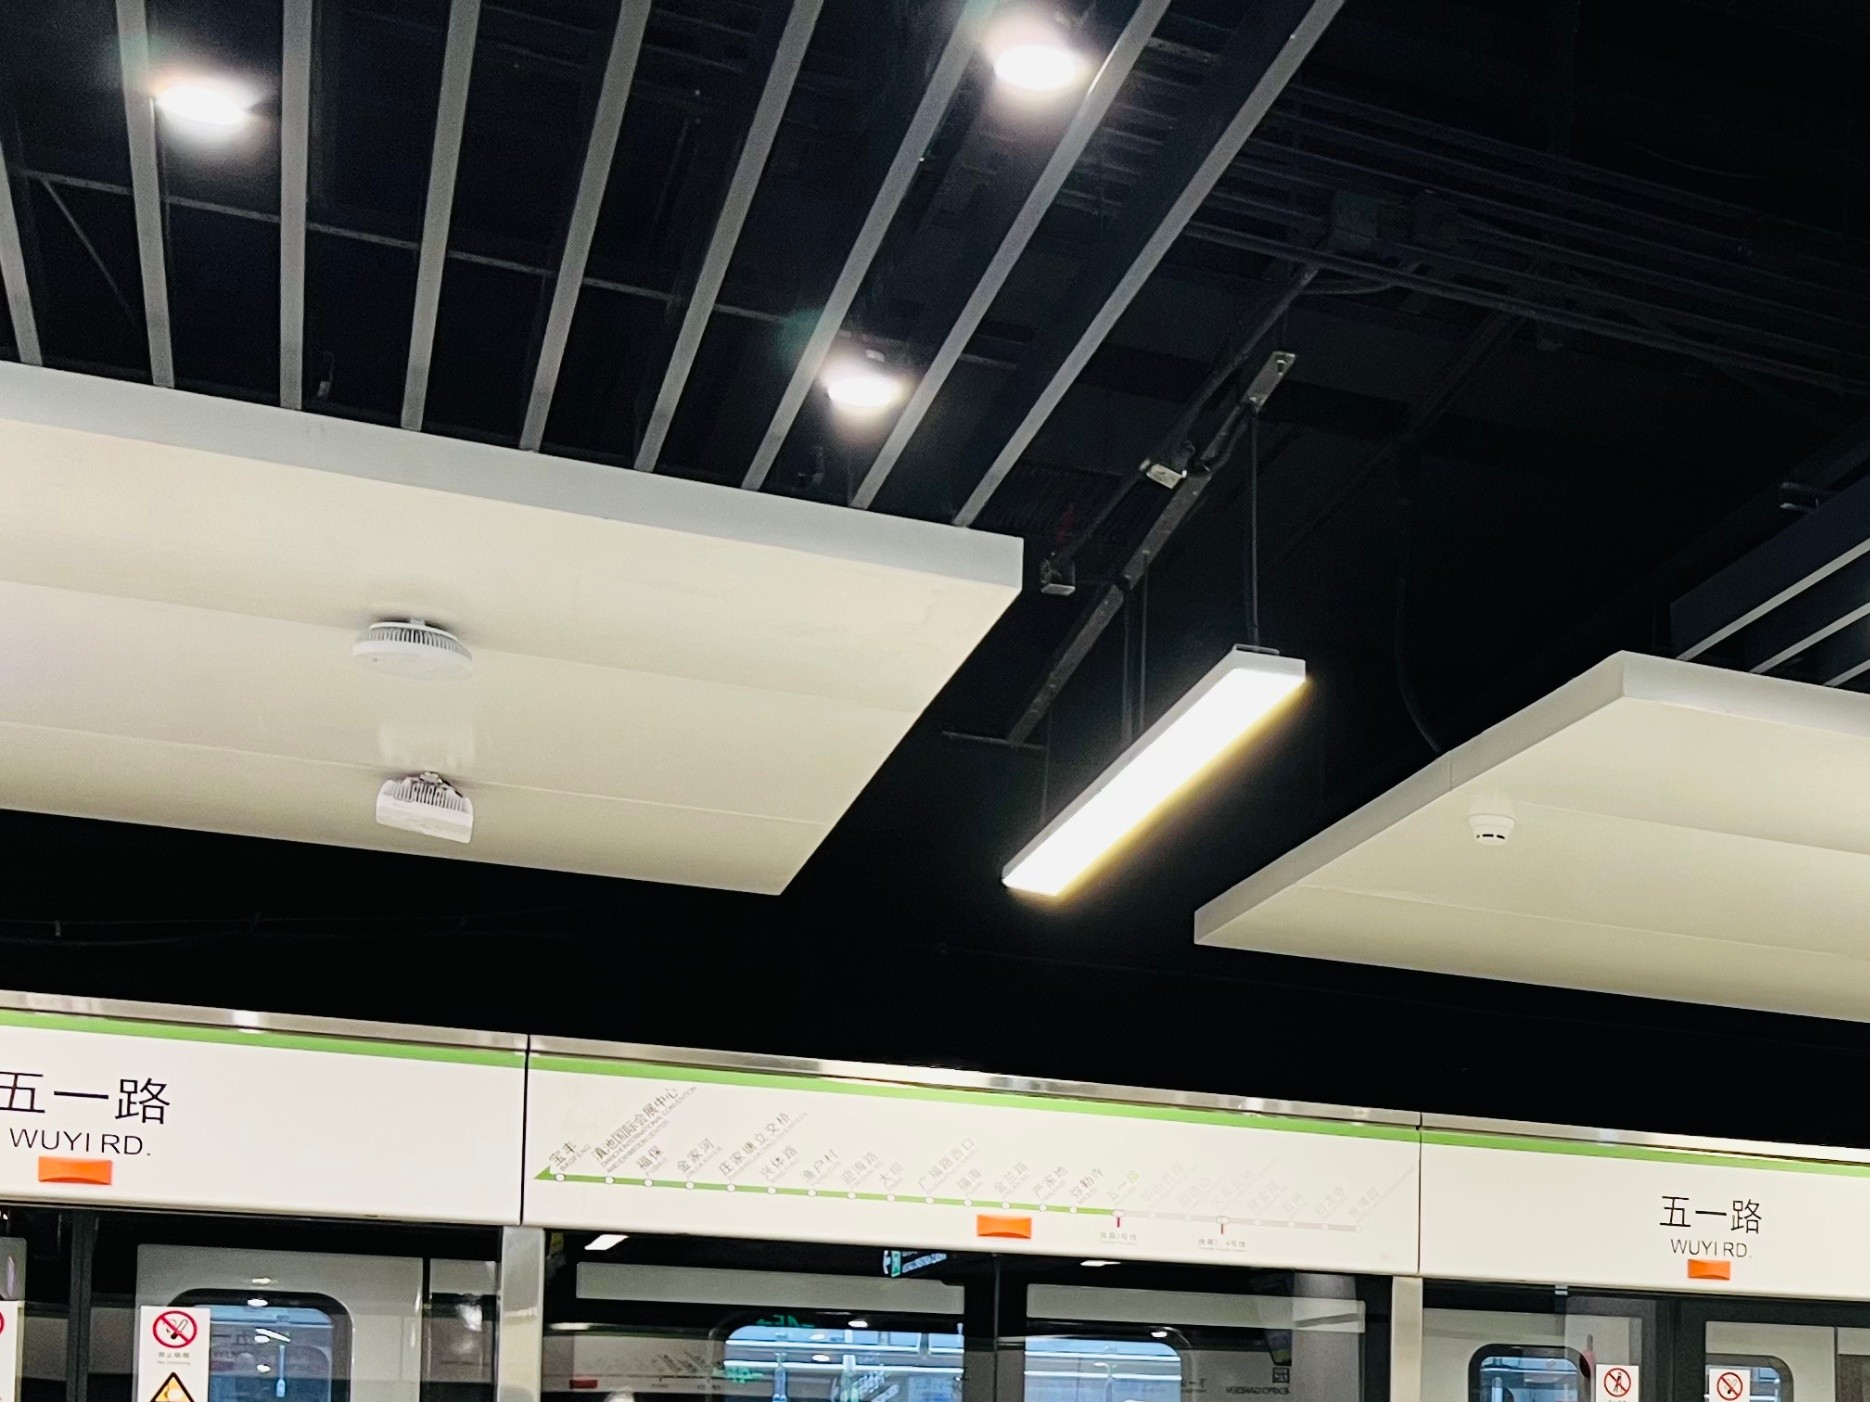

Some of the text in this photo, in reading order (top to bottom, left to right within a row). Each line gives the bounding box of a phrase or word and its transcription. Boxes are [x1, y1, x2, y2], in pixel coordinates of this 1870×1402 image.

[0, 1071, 171, 1125] 五一路
[9, 1127, 91, 1152] WUYI
[1659, 1196, 1762, 1234] 五一路
[1670, 1239, 1718, 1256] WUYI
